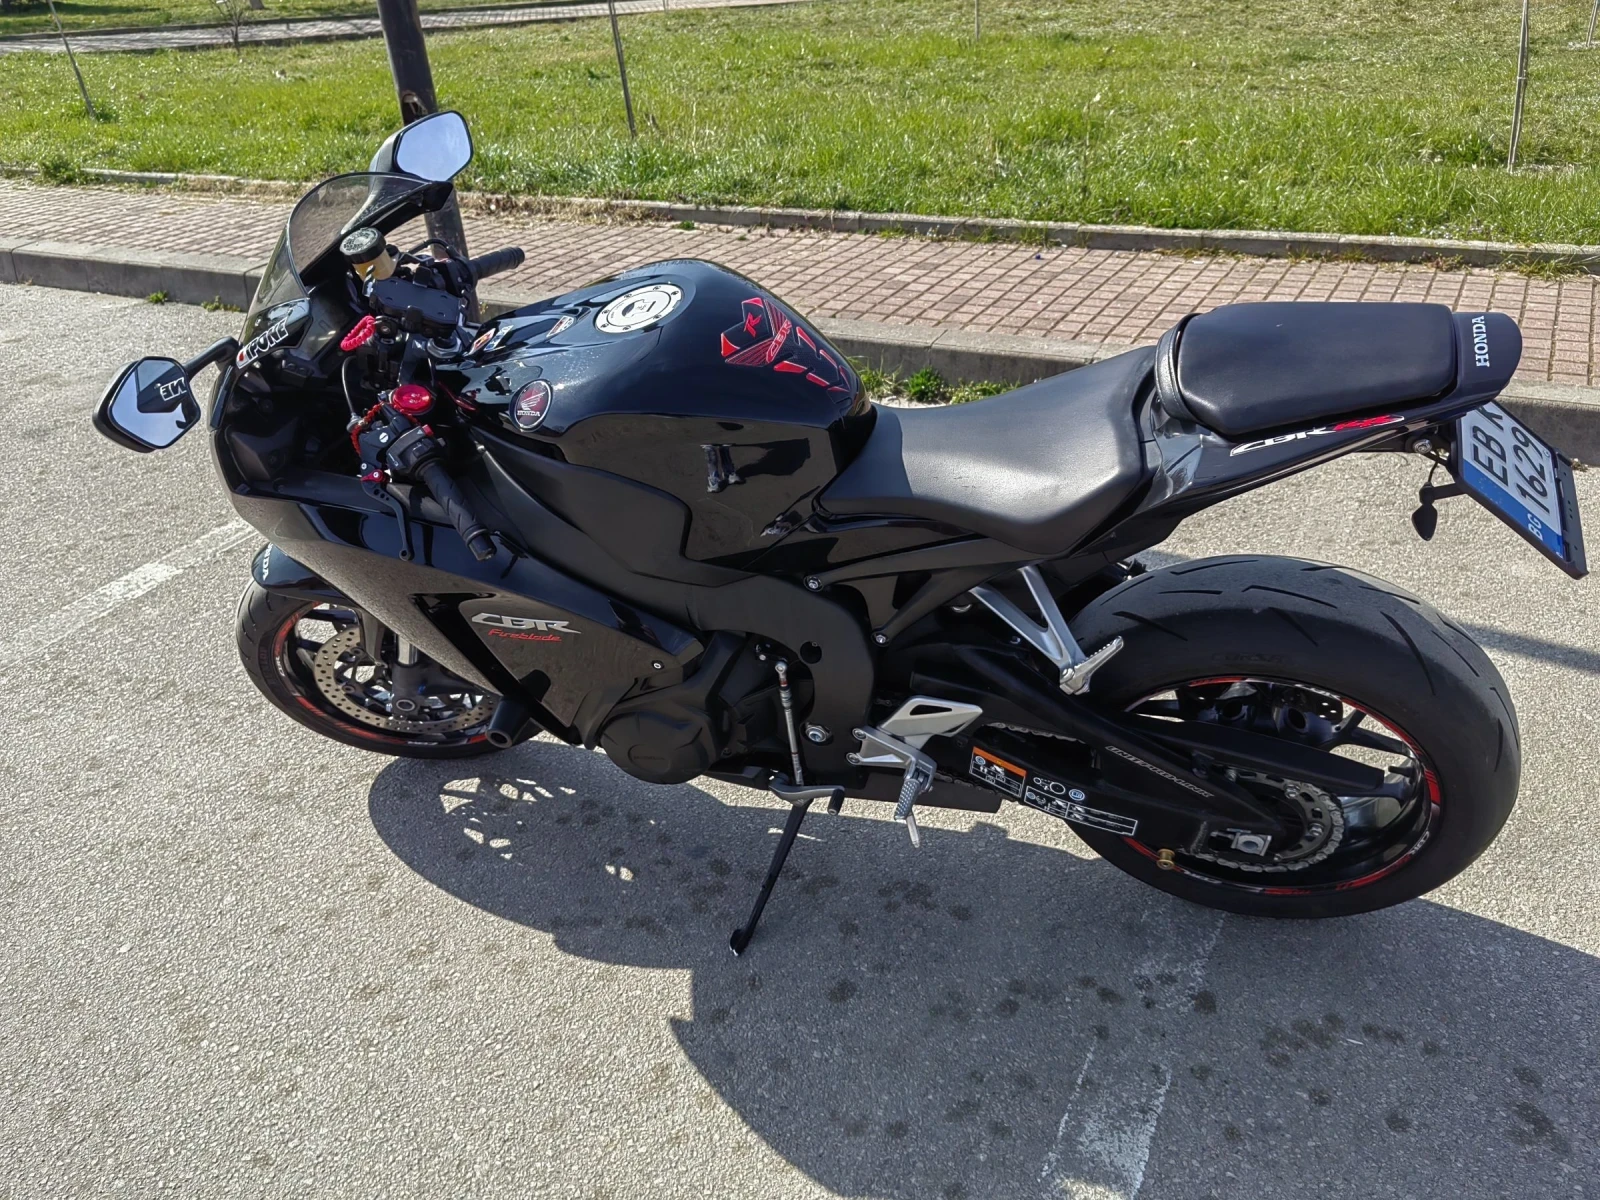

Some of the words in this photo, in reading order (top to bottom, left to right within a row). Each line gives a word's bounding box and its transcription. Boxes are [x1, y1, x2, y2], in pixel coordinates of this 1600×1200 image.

[243, 316, 289, 361] IPONE
[1471, 315, 1490, 367] HONDA
[1230, 427, 1336, 457] CBR
[1472, 425, 1509, 487] EB
[1511, 426, 1550, 514] 1629
[1527, 512, 1544, 541] BG
[471, 612, 582, 635] CBR
[487, 628, 562, 643] Fireblade
